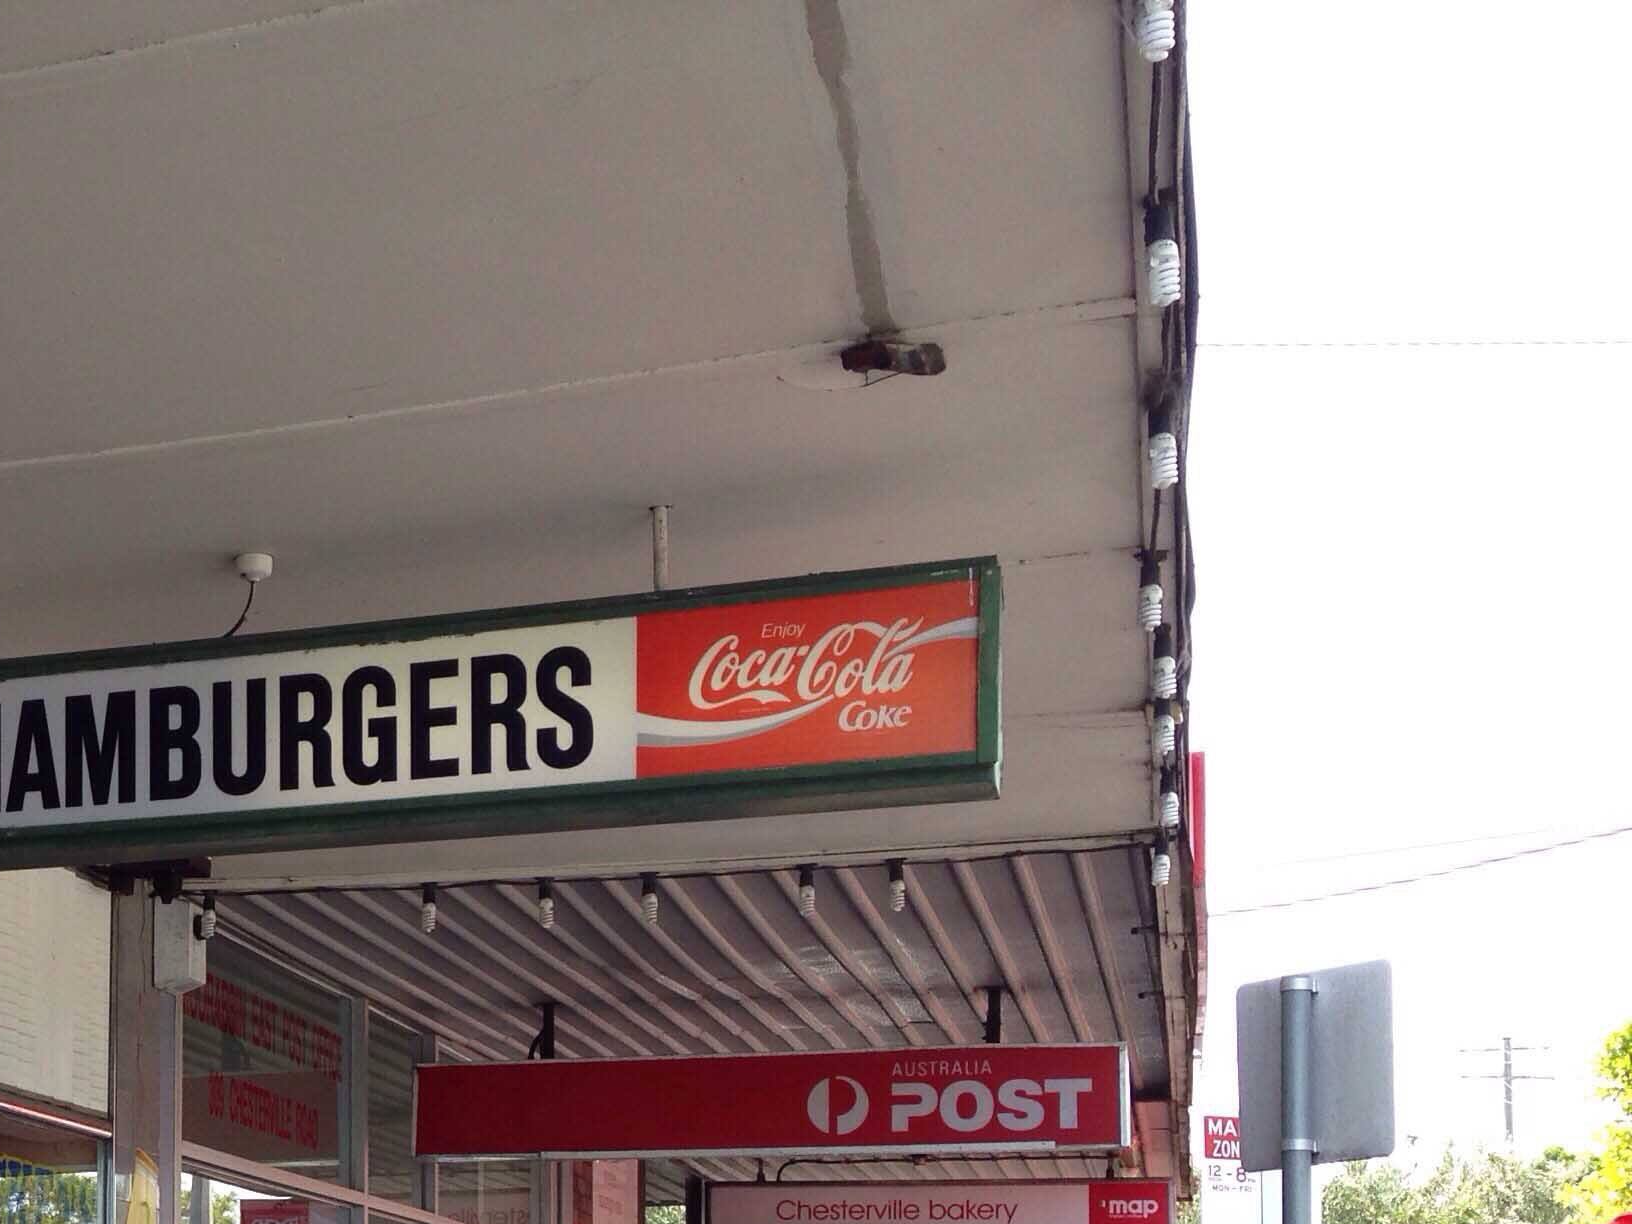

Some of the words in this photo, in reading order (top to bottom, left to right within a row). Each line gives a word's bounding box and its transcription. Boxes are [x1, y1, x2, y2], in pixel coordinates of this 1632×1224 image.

[761, 622, 805, 641] Enjoy
[689, 615, 924, 710] Coca-Cola
[838, 700, 912, 732] Coke
[892, 1060, 993, 1077] AUSTRALIA
[891, 1077, 1093, 1133] POST
[776, 1197, 921, 1222] Chesterville
[928, 1198, 1018, 1224] bakery
